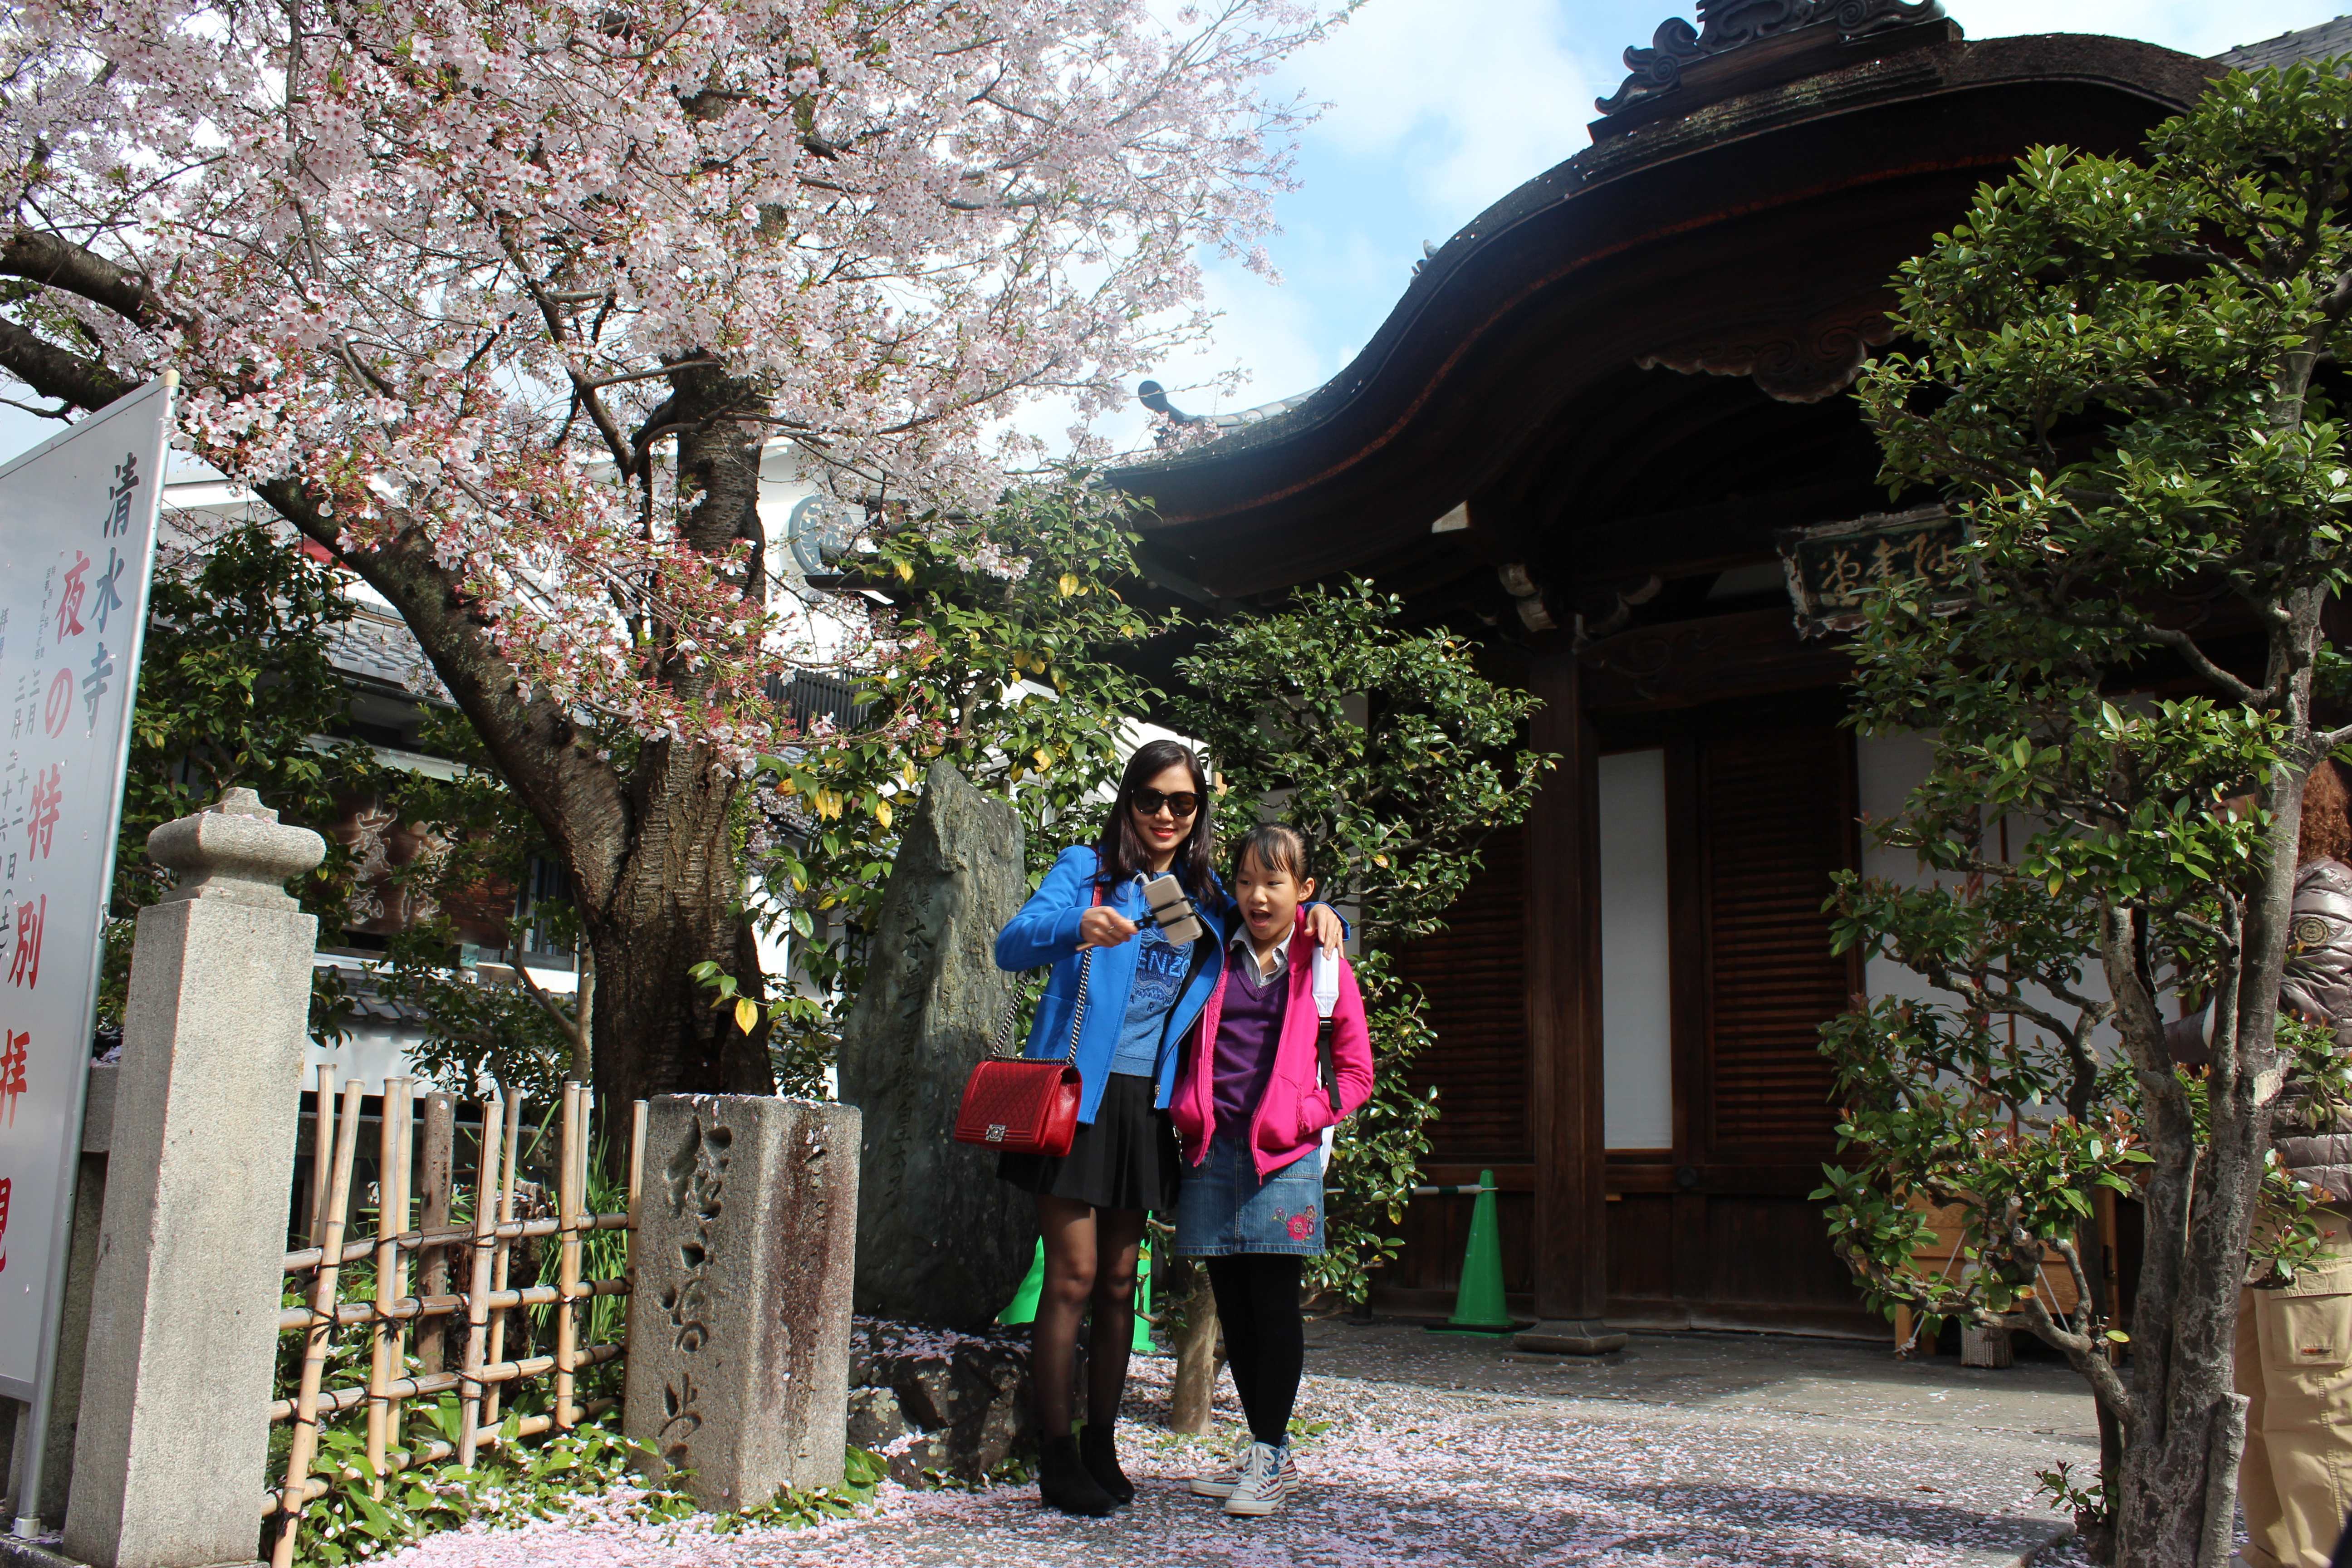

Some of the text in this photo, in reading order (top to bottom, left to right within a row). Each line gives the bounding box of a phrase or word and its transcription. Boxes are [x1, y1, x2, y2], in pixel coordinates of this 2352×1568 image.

[83, 452, 139, 730] 清水寺
[1137, 949, 1191, 979] ENZO
